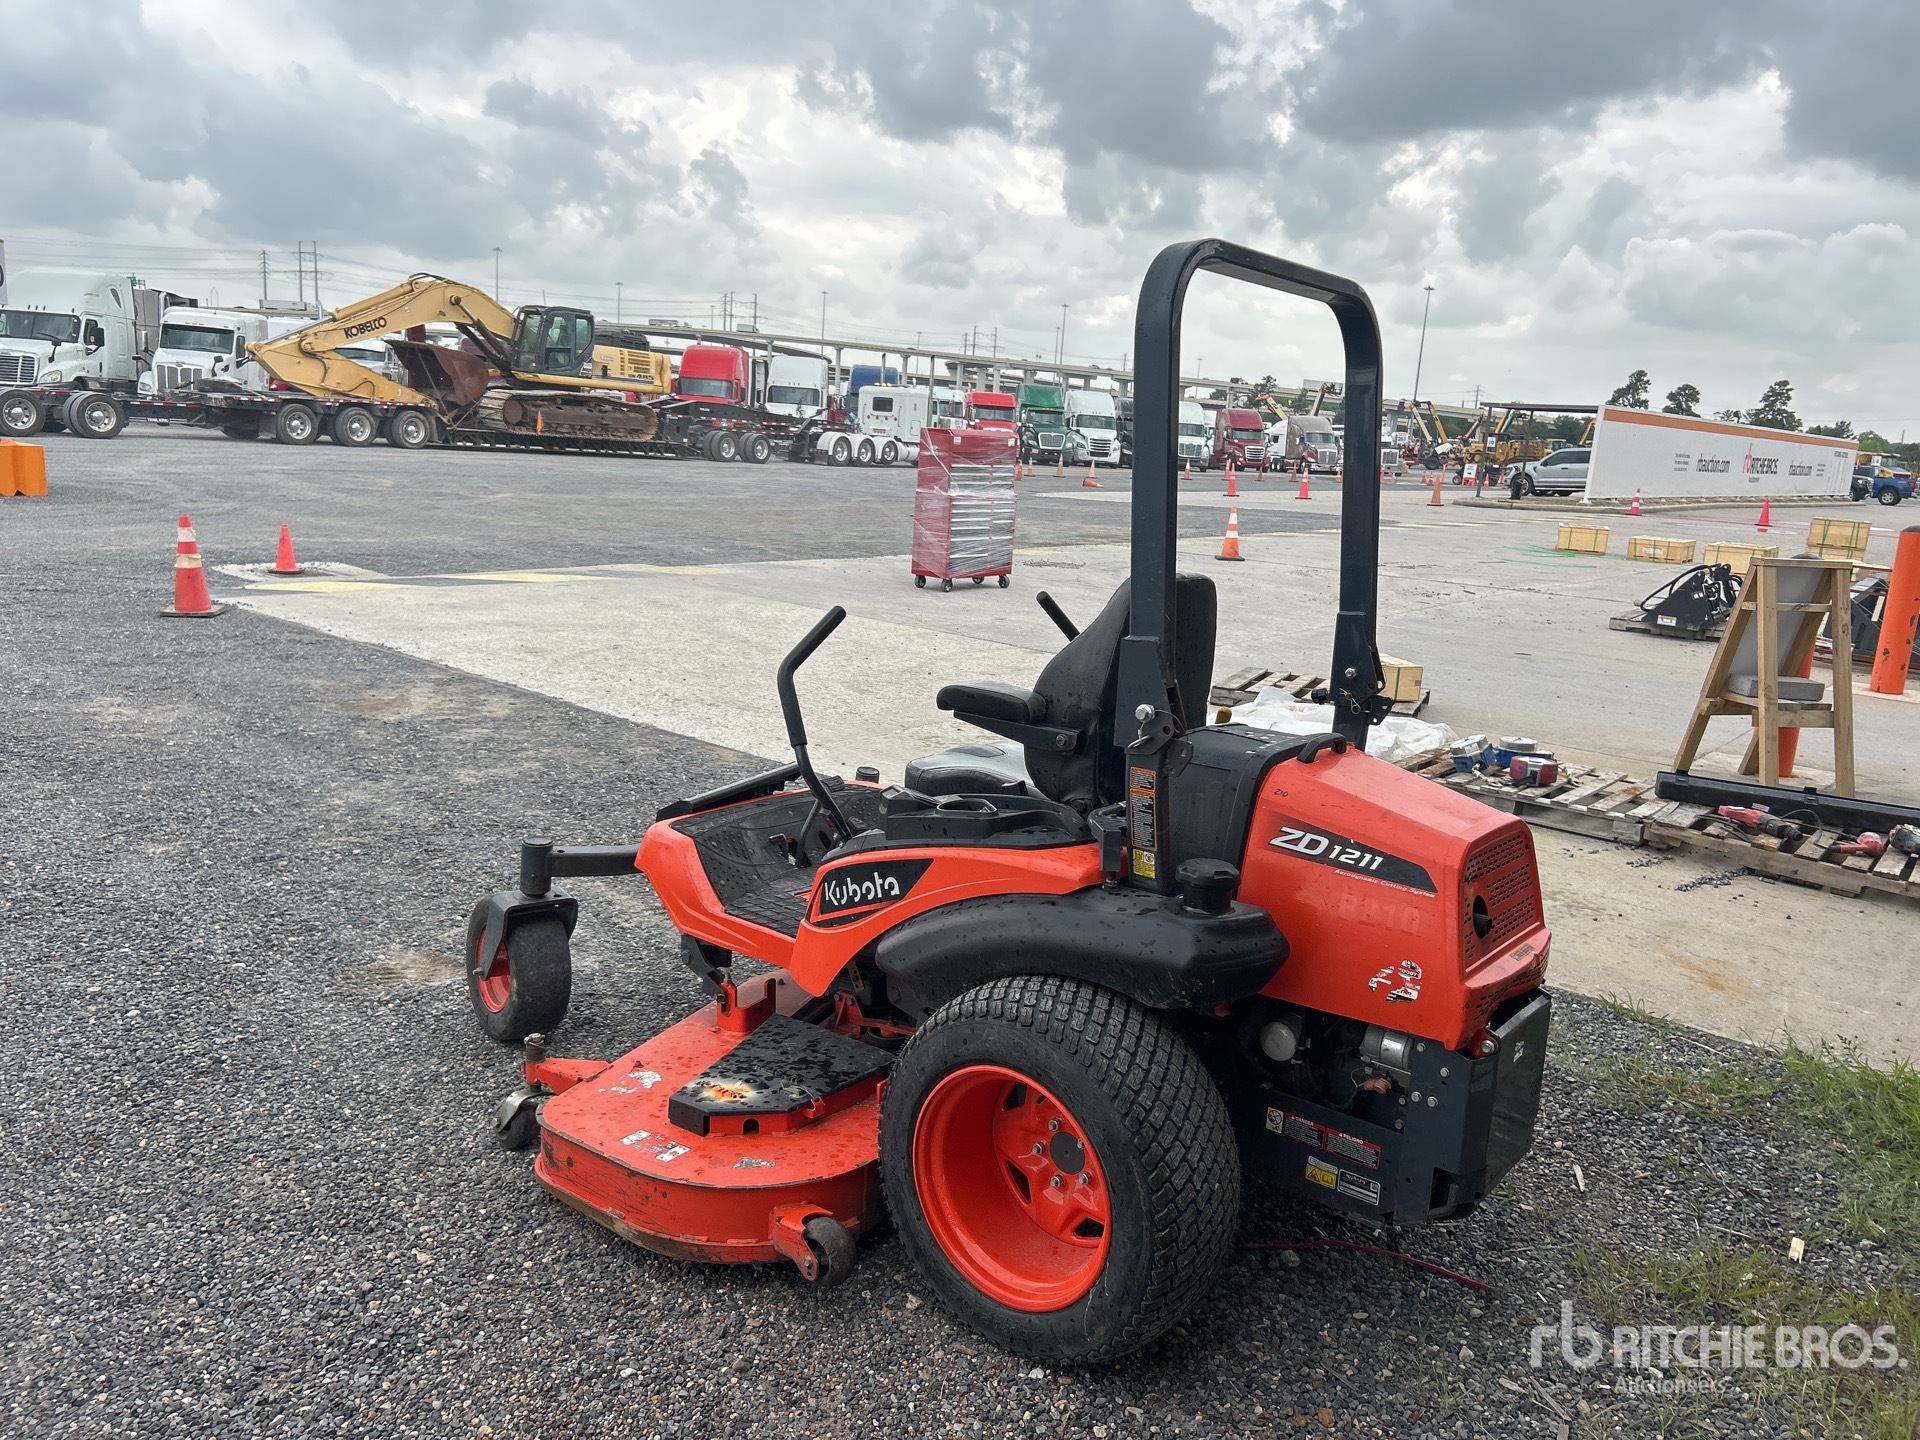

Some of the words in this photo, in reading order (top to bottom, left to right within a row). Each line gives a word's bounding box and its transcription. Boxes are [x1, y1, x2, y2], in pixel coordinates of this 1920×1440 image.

[343, 316, 388, 339] KOBELCO
[824, 872, 900, 906] Kubota
[1334, 869, 1378, 884] Aerodynamic
[1380, 880, 1408, 892] Cutting
[1409, 887, 1436, 898] System
